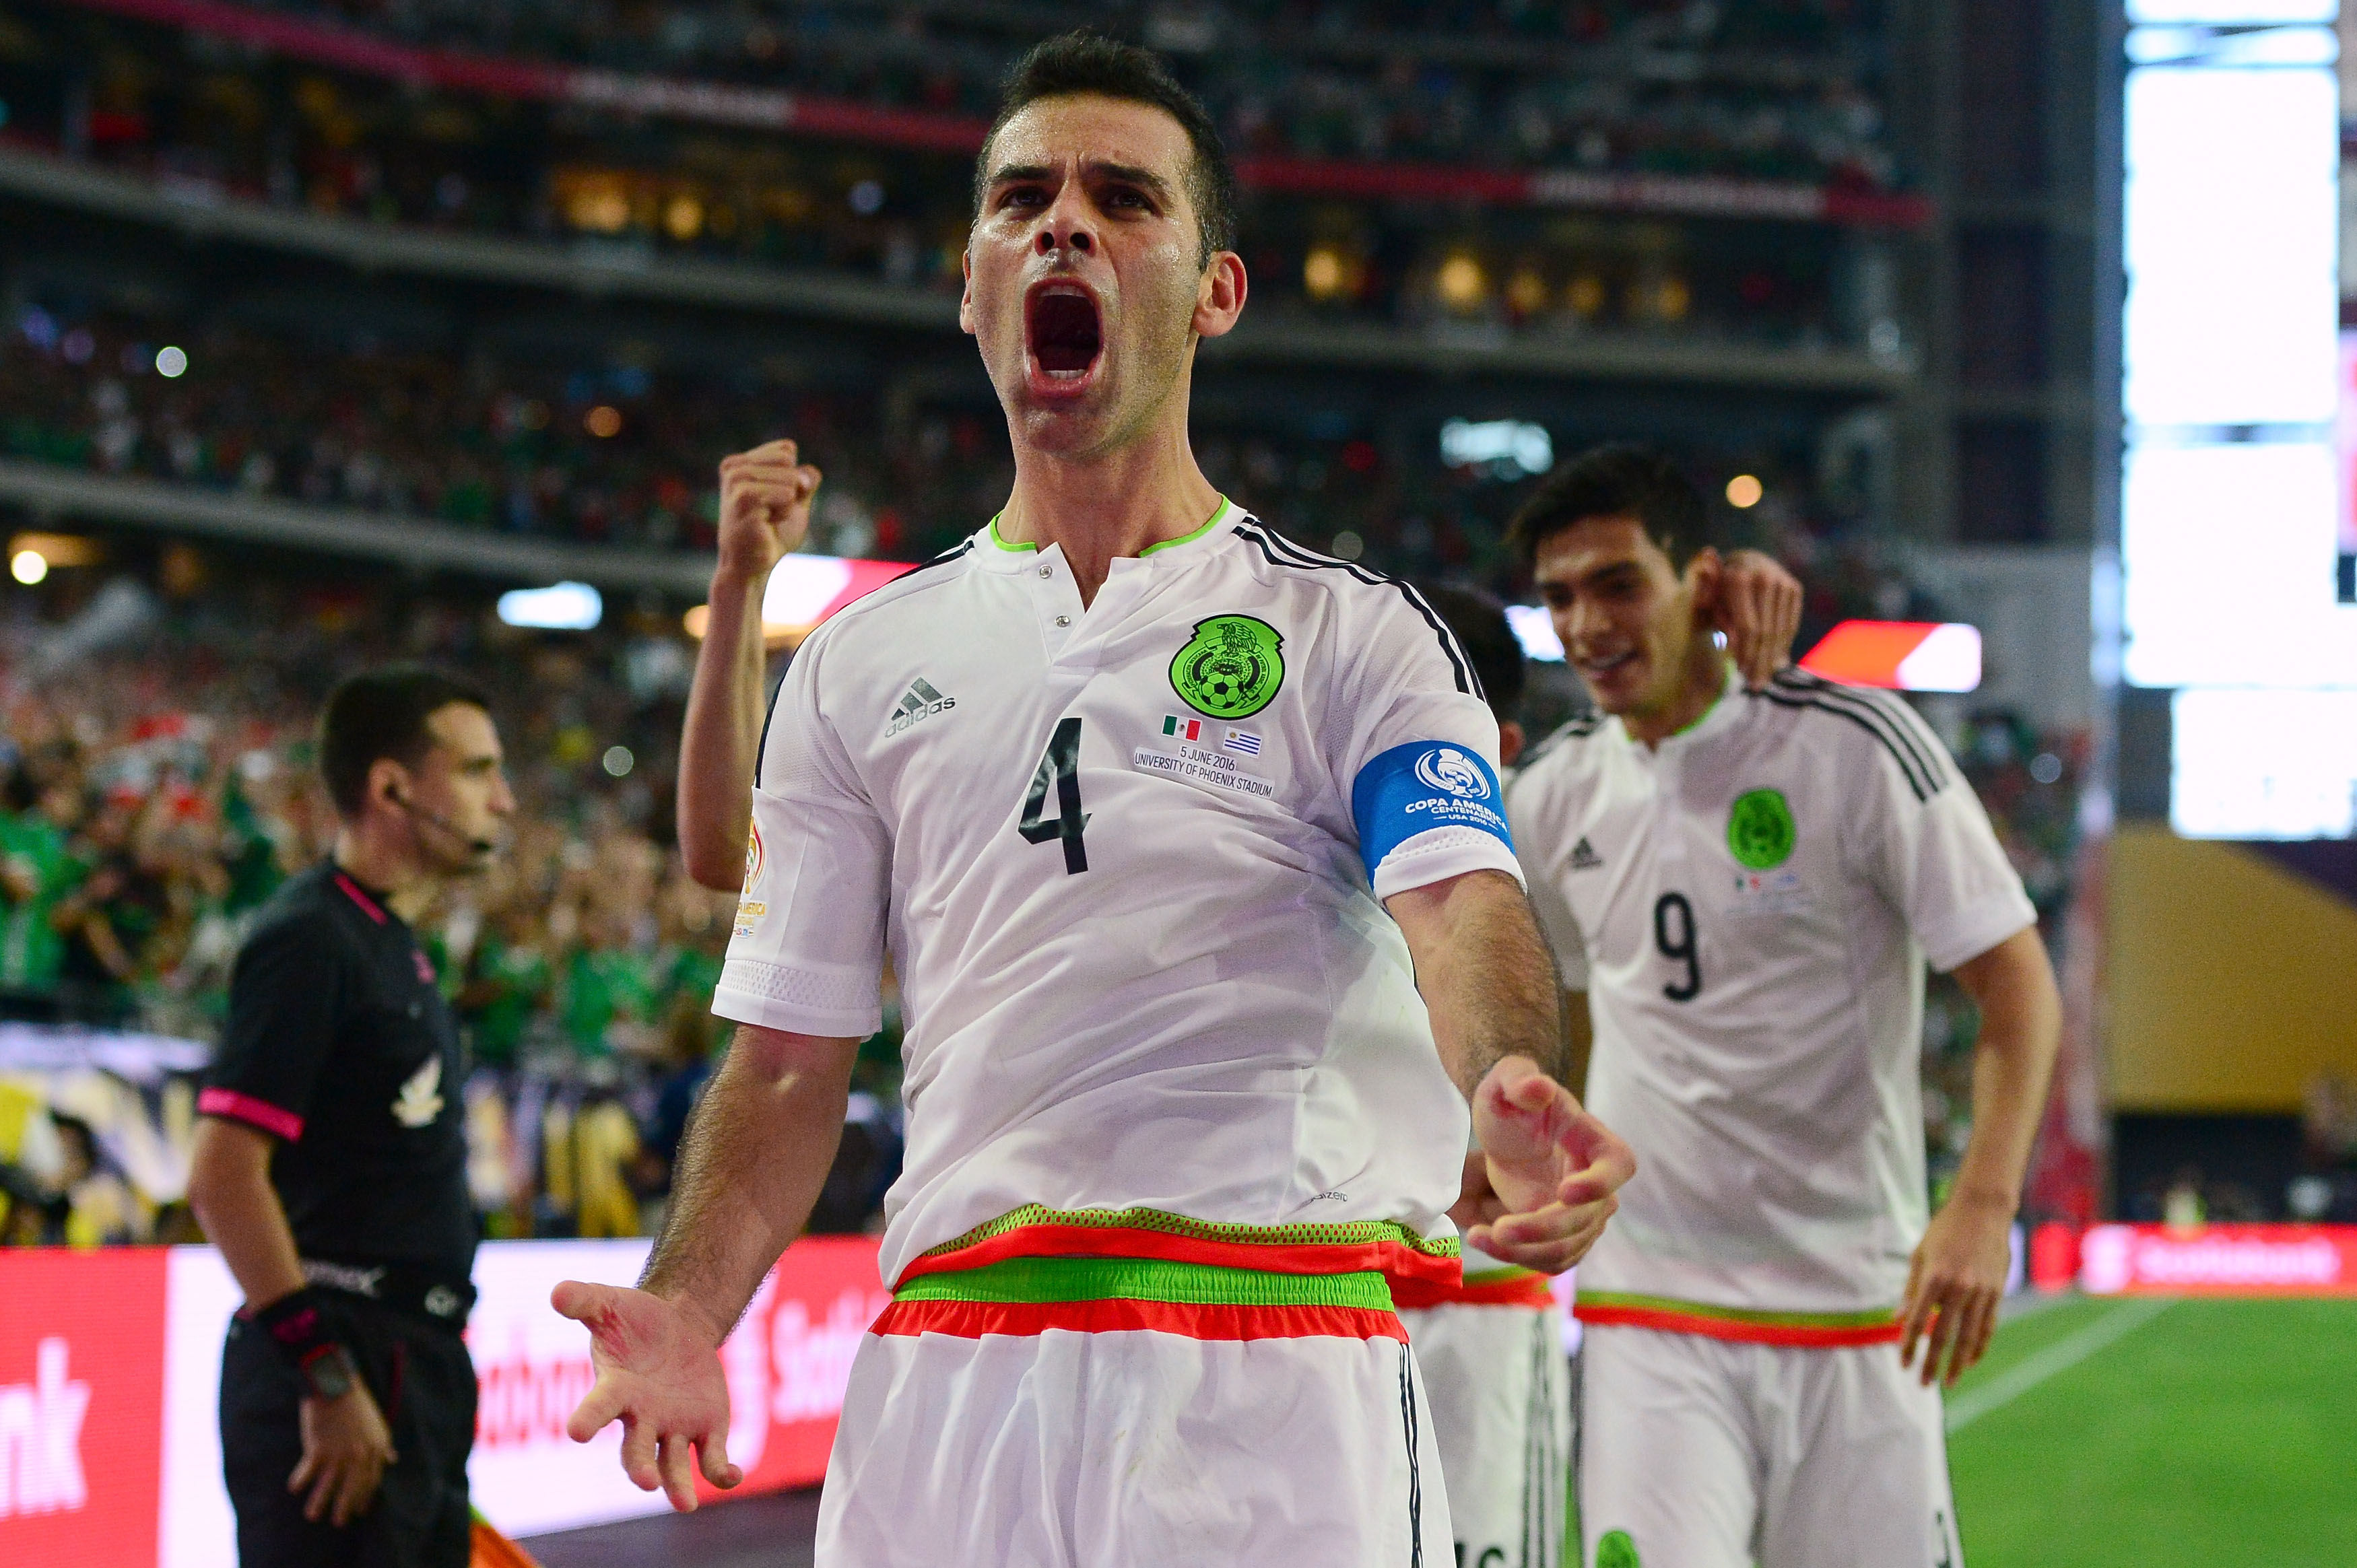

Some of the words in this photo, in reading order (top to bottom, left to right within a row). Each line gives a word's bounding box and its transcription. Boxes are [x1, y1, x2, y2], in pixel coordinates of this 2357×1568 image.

[885, 697, 956, 738] adidas
[1135, 753, 1185, 773] UNIVERSITY
[1185, 763, 1198, 776] OF
[1199, 768, 1236, 788] PHOENIX
[1236, 778, 1273, 798] STADIUM
[1180, 746, 1187, 758] 5
[1188, 749, 1212, 765] JUNE
[1213, 755, 1235, 771] 2016
[1018, 718, 1092, 875] 4
[1405, 798, 1449, 814] COPA
[1452, 798, 1508, 833] AMERICA
[1431, 807, 1496, 825] CENTENARIO
[1469, 815, 1488, 825] 2016
[1654, 891, 1700, 1002] 9
